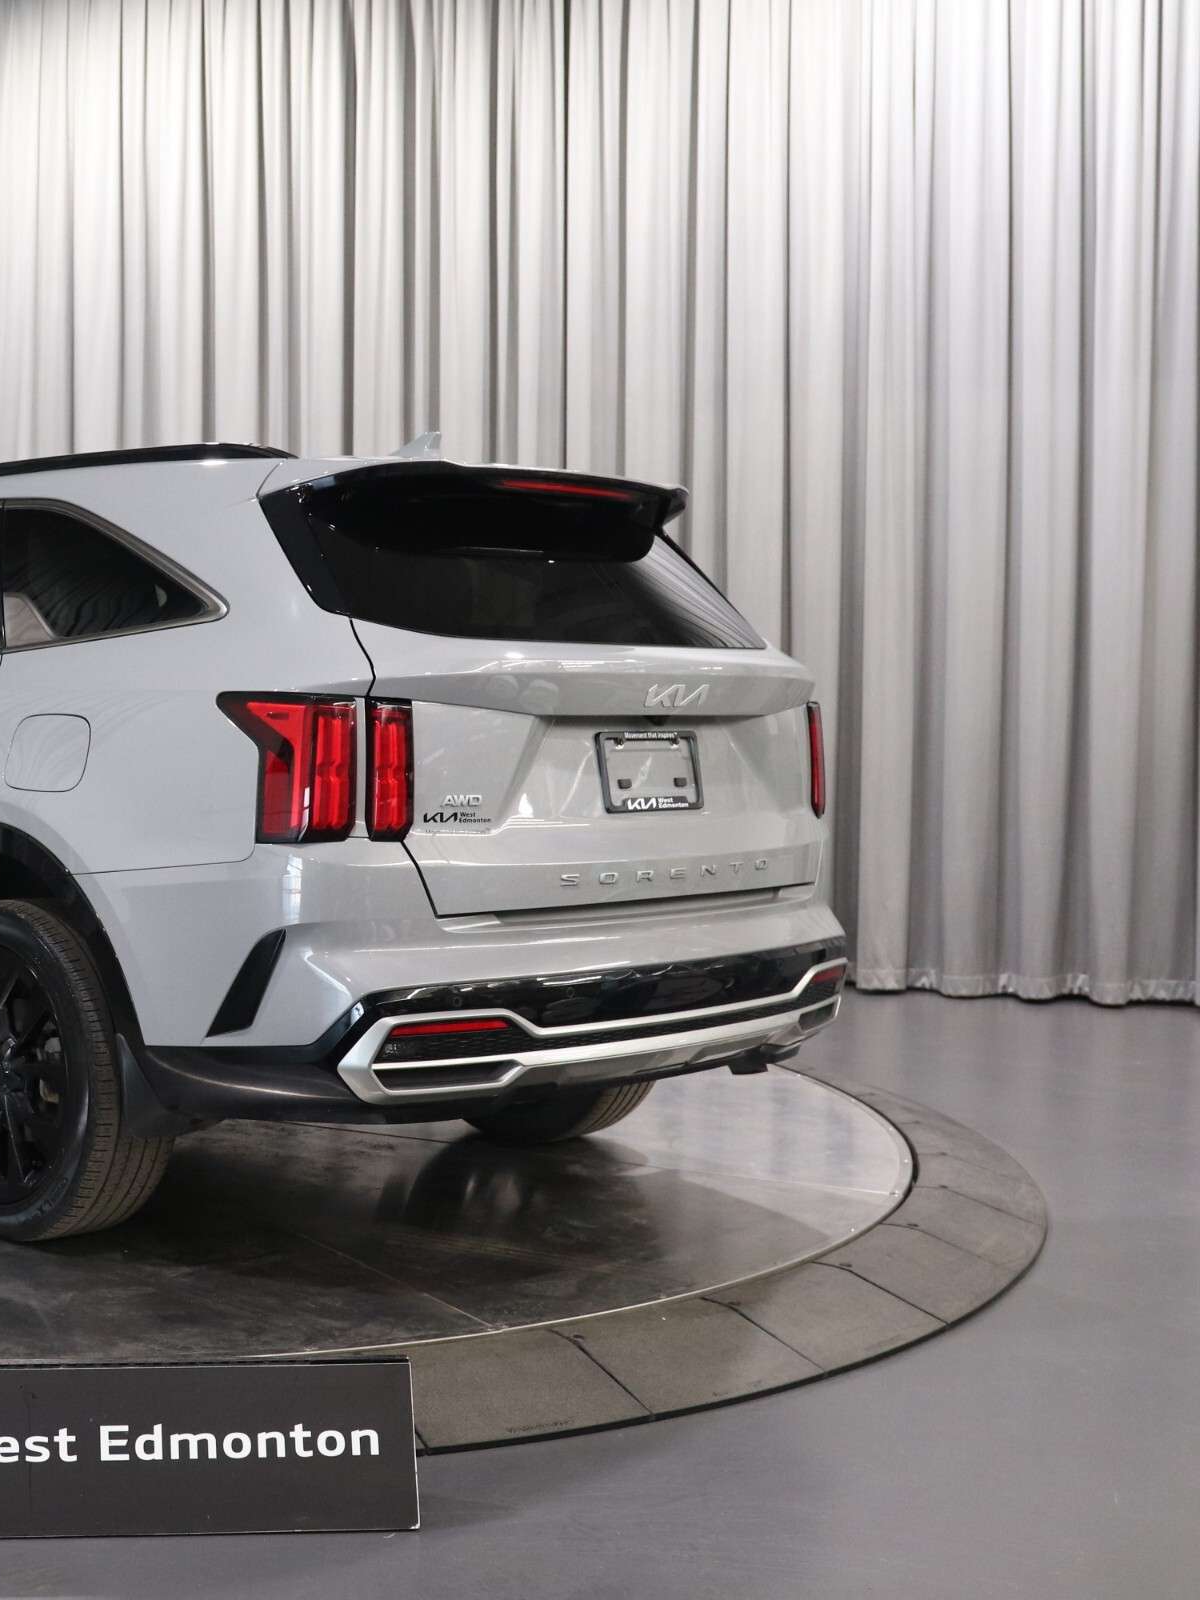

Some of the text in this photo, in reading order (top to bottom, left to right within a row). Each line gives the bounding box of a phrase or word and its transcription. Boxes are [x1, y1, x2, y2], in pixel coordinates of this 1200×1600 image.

[643, 683, 710, 707] KIA
[647, 731, 657, 739] that
[441, 794, 482, 807] AWD
[627, 797, 657, 810] KIA
[423, 811, 458, 823] KIA
[560, 858, 769, 887] SORENTO
[99, 1424, 380, 1462] Edmonton
